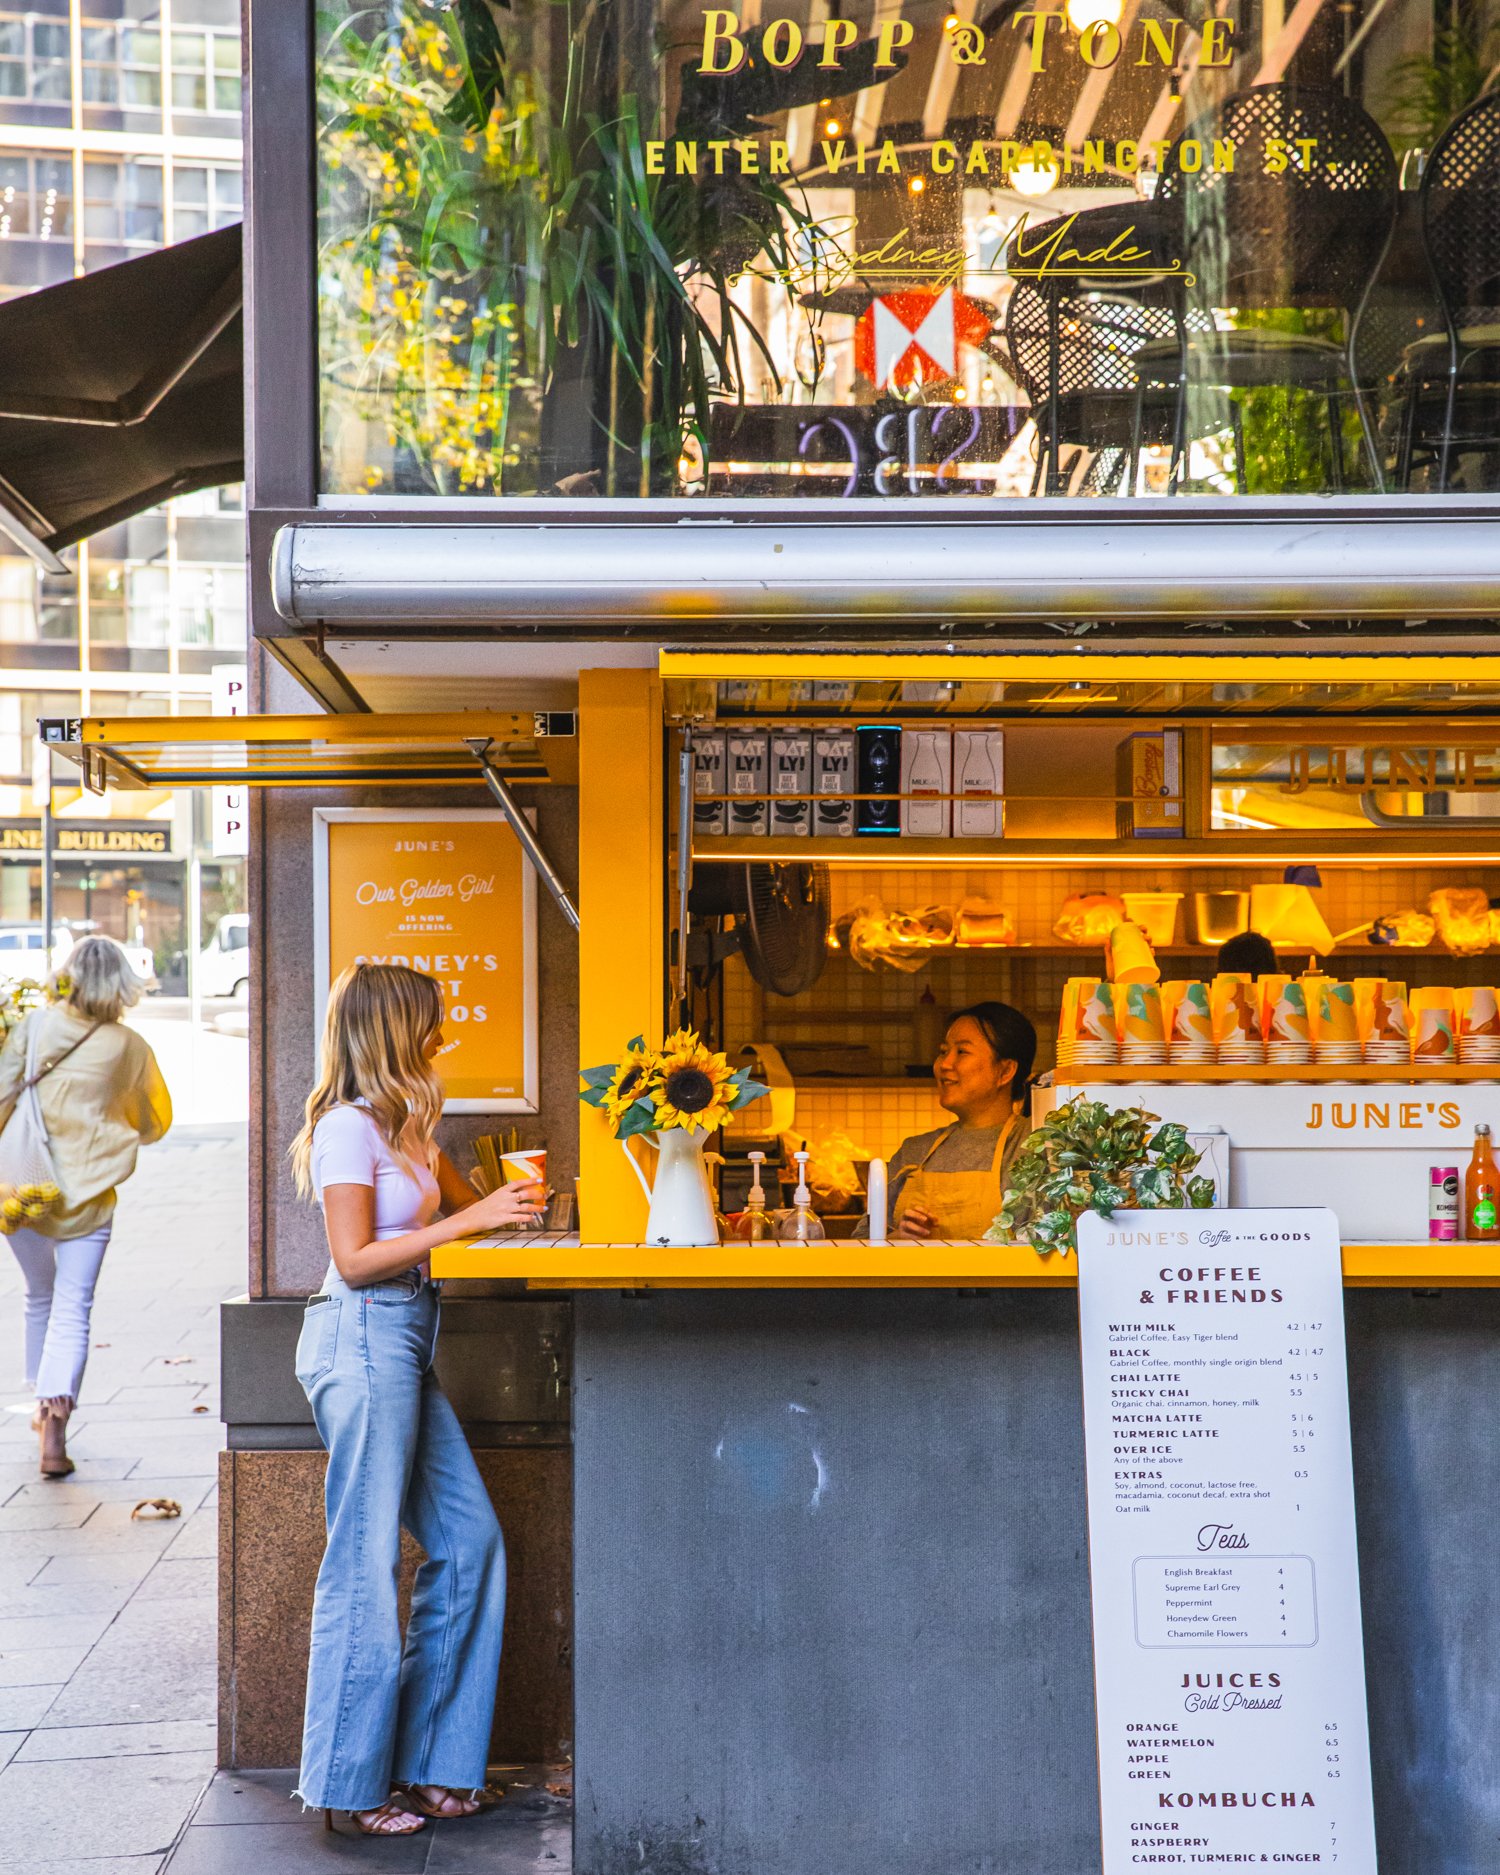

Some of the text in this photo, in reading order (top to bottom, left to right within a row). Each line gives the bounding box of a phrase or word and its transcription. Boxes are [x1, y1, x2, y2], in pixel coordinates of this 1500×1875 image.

[696, 10, 914, 76] BOPP
[1012, 11, 1236, 73] TONE
[646, 141, 790, 174] ENTER
[822, 141, 901, 173] VIA
[931, 139, 1234, 174] CARRINGTON
[780, 211, 1151, 297] Sydney Made
[779, 756, 805, 771] LY!
[822, 757, 848, 771] LY!
[0, 830, 165, 851] INE BUILDING
[394, 841, 455, 852] JUNE'S
[356, 874, 496, 907] Our Golden Girl
[1306, 1102, 1461, 1129] JUNE'S
[1106, 1232, 1189, 1246] JUNE'S
[1199, 1230, 1232, 1247] Coffee
[1260, 1233, 1311, 1241] GOODS
[1159, 1268, 1261, 1281] COFFEE
[1140, 1289, 1282, 1304] & FRIENDS
[1173, 1334, 1190, 1342] Easy
[1193, 1334, 1212, 1342] Tiger
[1110, 1349, 1150, 1357] BLACK
[1174, 1359, 1206, 1367] monthly
[1210, 1359, 1232, 1367] single
[1235, 1359, 1257, 1367] origin
[1112, 1400, 1142, 1408] Organic
[1115, 1482, 1131, 1490] Soy,
[1197, 1524, 1249, 1551] Teas
[1165, 1569, 1192, 1577] English
[1166, 1584, 1201, 1592] Supreme
[1222, 1584, 1240, 1592] Grey
[1166, 1600, 1212, 1608] Peppermint
[1167, 1615, 1209, 1623] Honeydew
[1181, 1673, 1280, 1688] JUICES
[1185, 1692, 1282, 1712] Cold Pressed
[1127, 1739, 1214, 1747] WATERMELON
[1128, 1755, 1168, 1763] APPLE
[1129, 1771, 1170, 1779] GREEN
[1159, 1792, 1315, 1807] KOMBUCHA
[1132, 1838, 1209, 1846] RASPBERRY
[1132, 1855, 1185, 1863] CARROT,
[1190, 1854, 1255, 1862] TURMERIC
